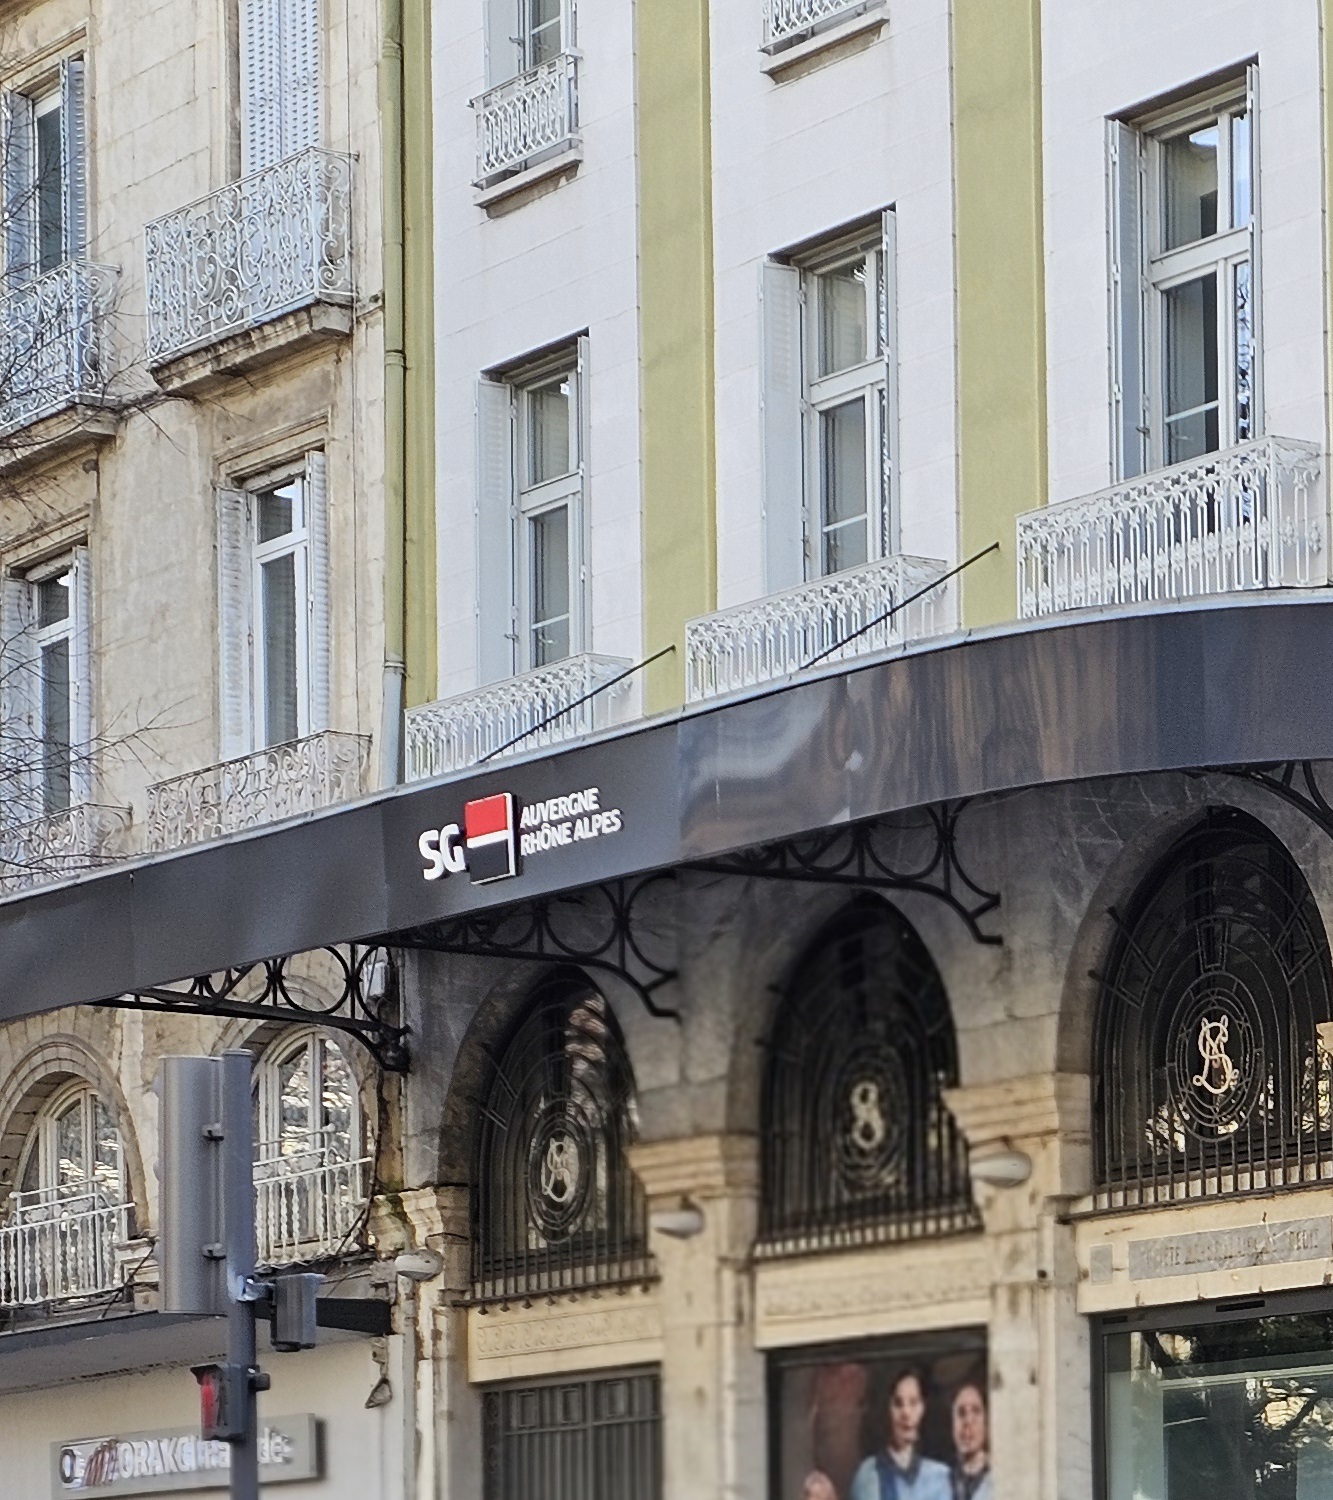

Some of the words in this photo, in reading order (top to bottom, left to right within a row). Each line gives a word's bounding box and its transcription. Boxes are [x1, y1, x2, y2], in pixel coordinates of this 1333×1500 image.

[519, 787, 600, 828] AUVERGNE
[418, 823, 467, 881] SG
[520, 823, 573, 857] RHÔNE
[573, 808, 623, 841] ALPES
